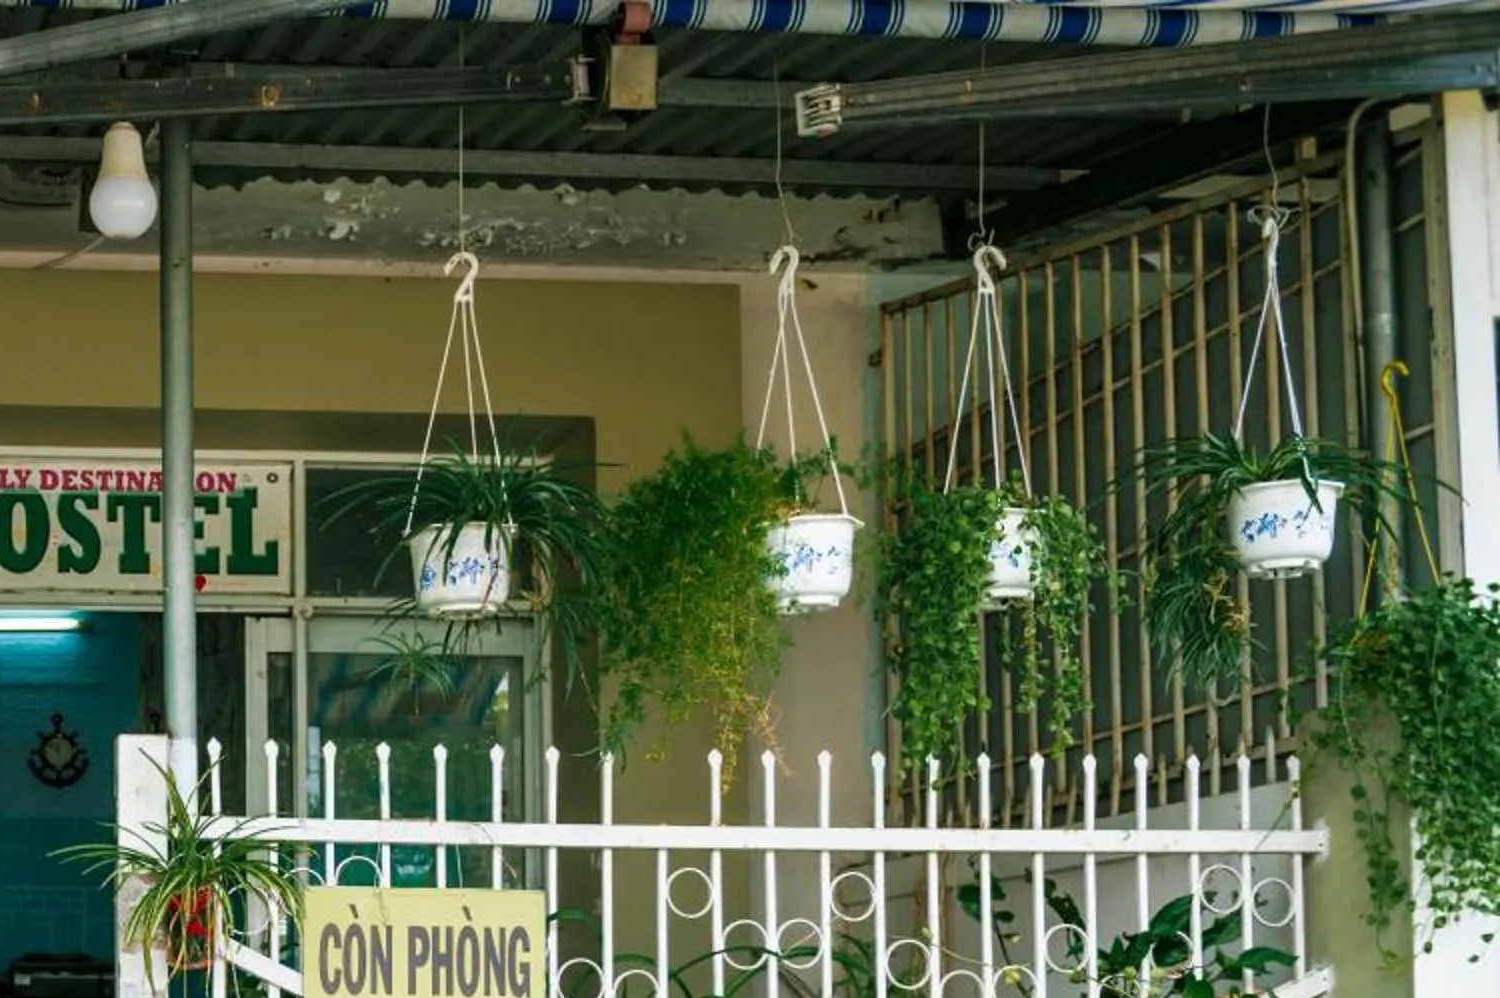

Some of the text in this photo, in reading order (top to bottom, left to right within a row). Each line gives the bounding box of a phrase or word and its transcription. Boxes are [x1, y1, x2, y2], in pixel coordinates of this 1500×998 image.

[39, 469, 237, 493] DESTINAON
[319, 904, 531, 998] CÒN PHÒNG
